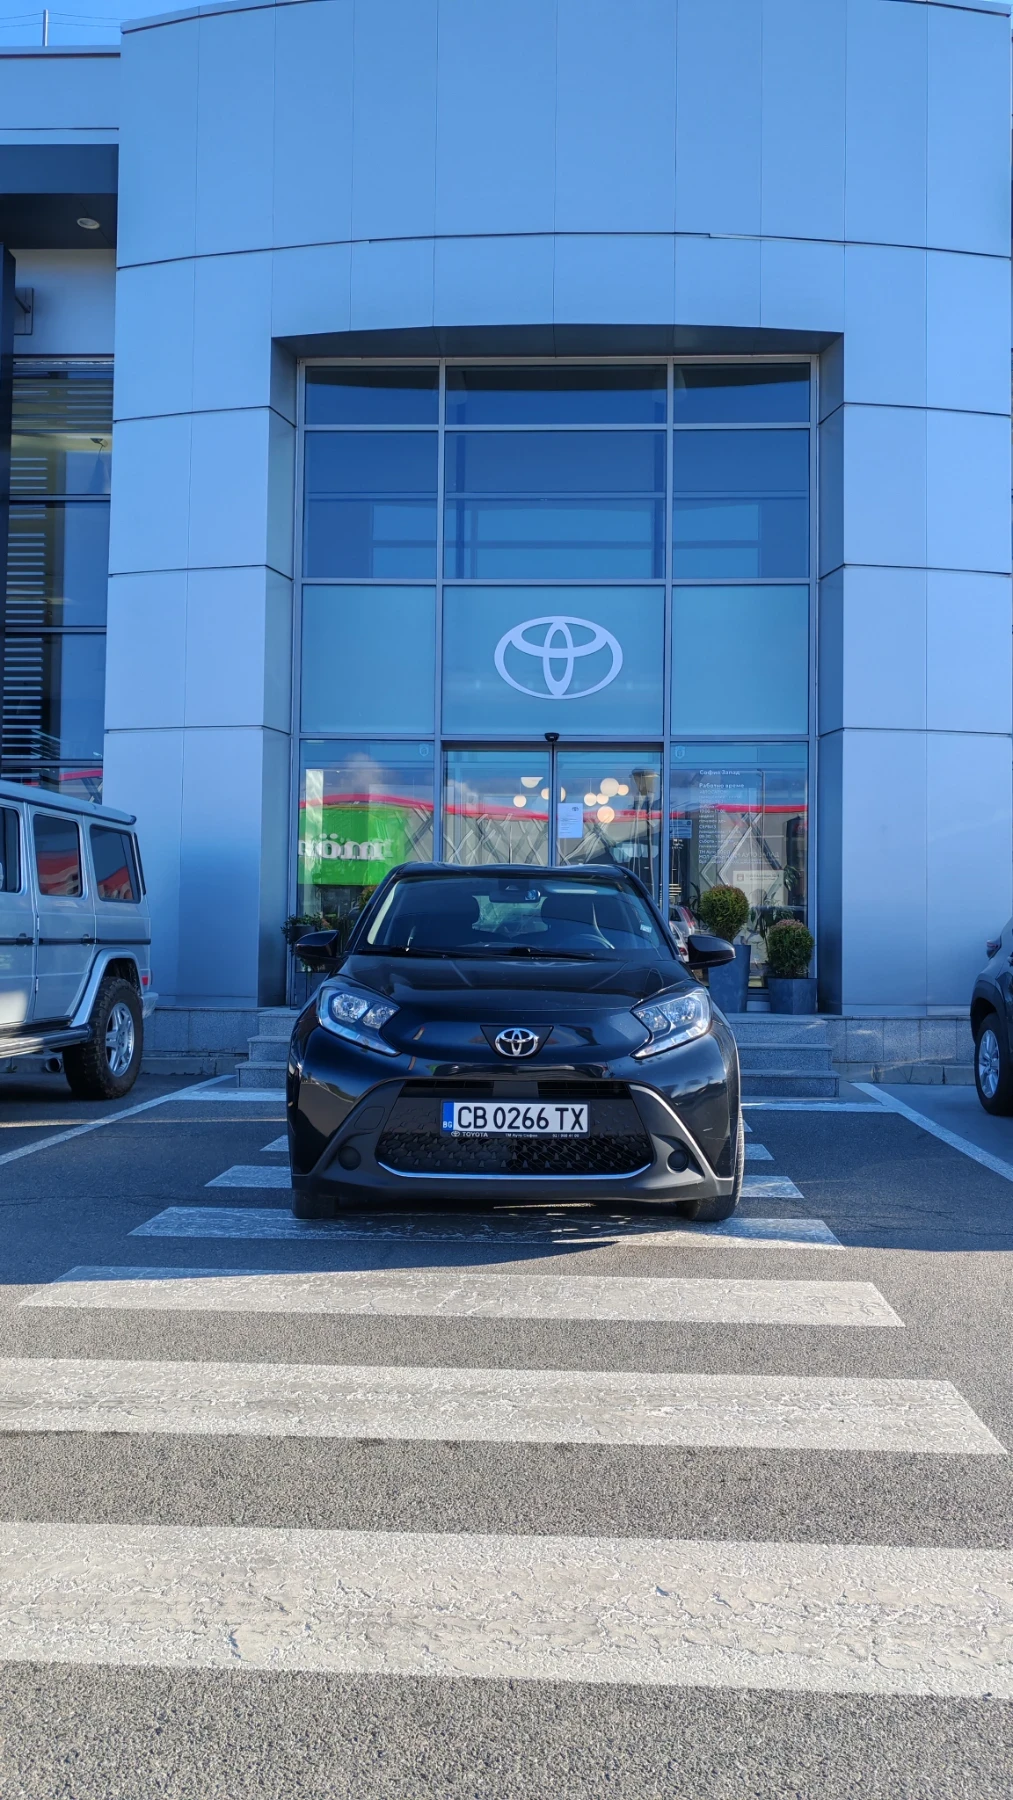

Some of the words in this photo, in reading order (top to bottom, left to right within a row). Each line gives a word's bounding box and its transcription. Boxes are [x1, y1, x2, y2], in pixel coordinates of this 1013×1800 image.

[458, 1106, 488, 1129] CB
[493, 1106, 550, 1130] 0266
[555, 1107, 584, 1131] TX
